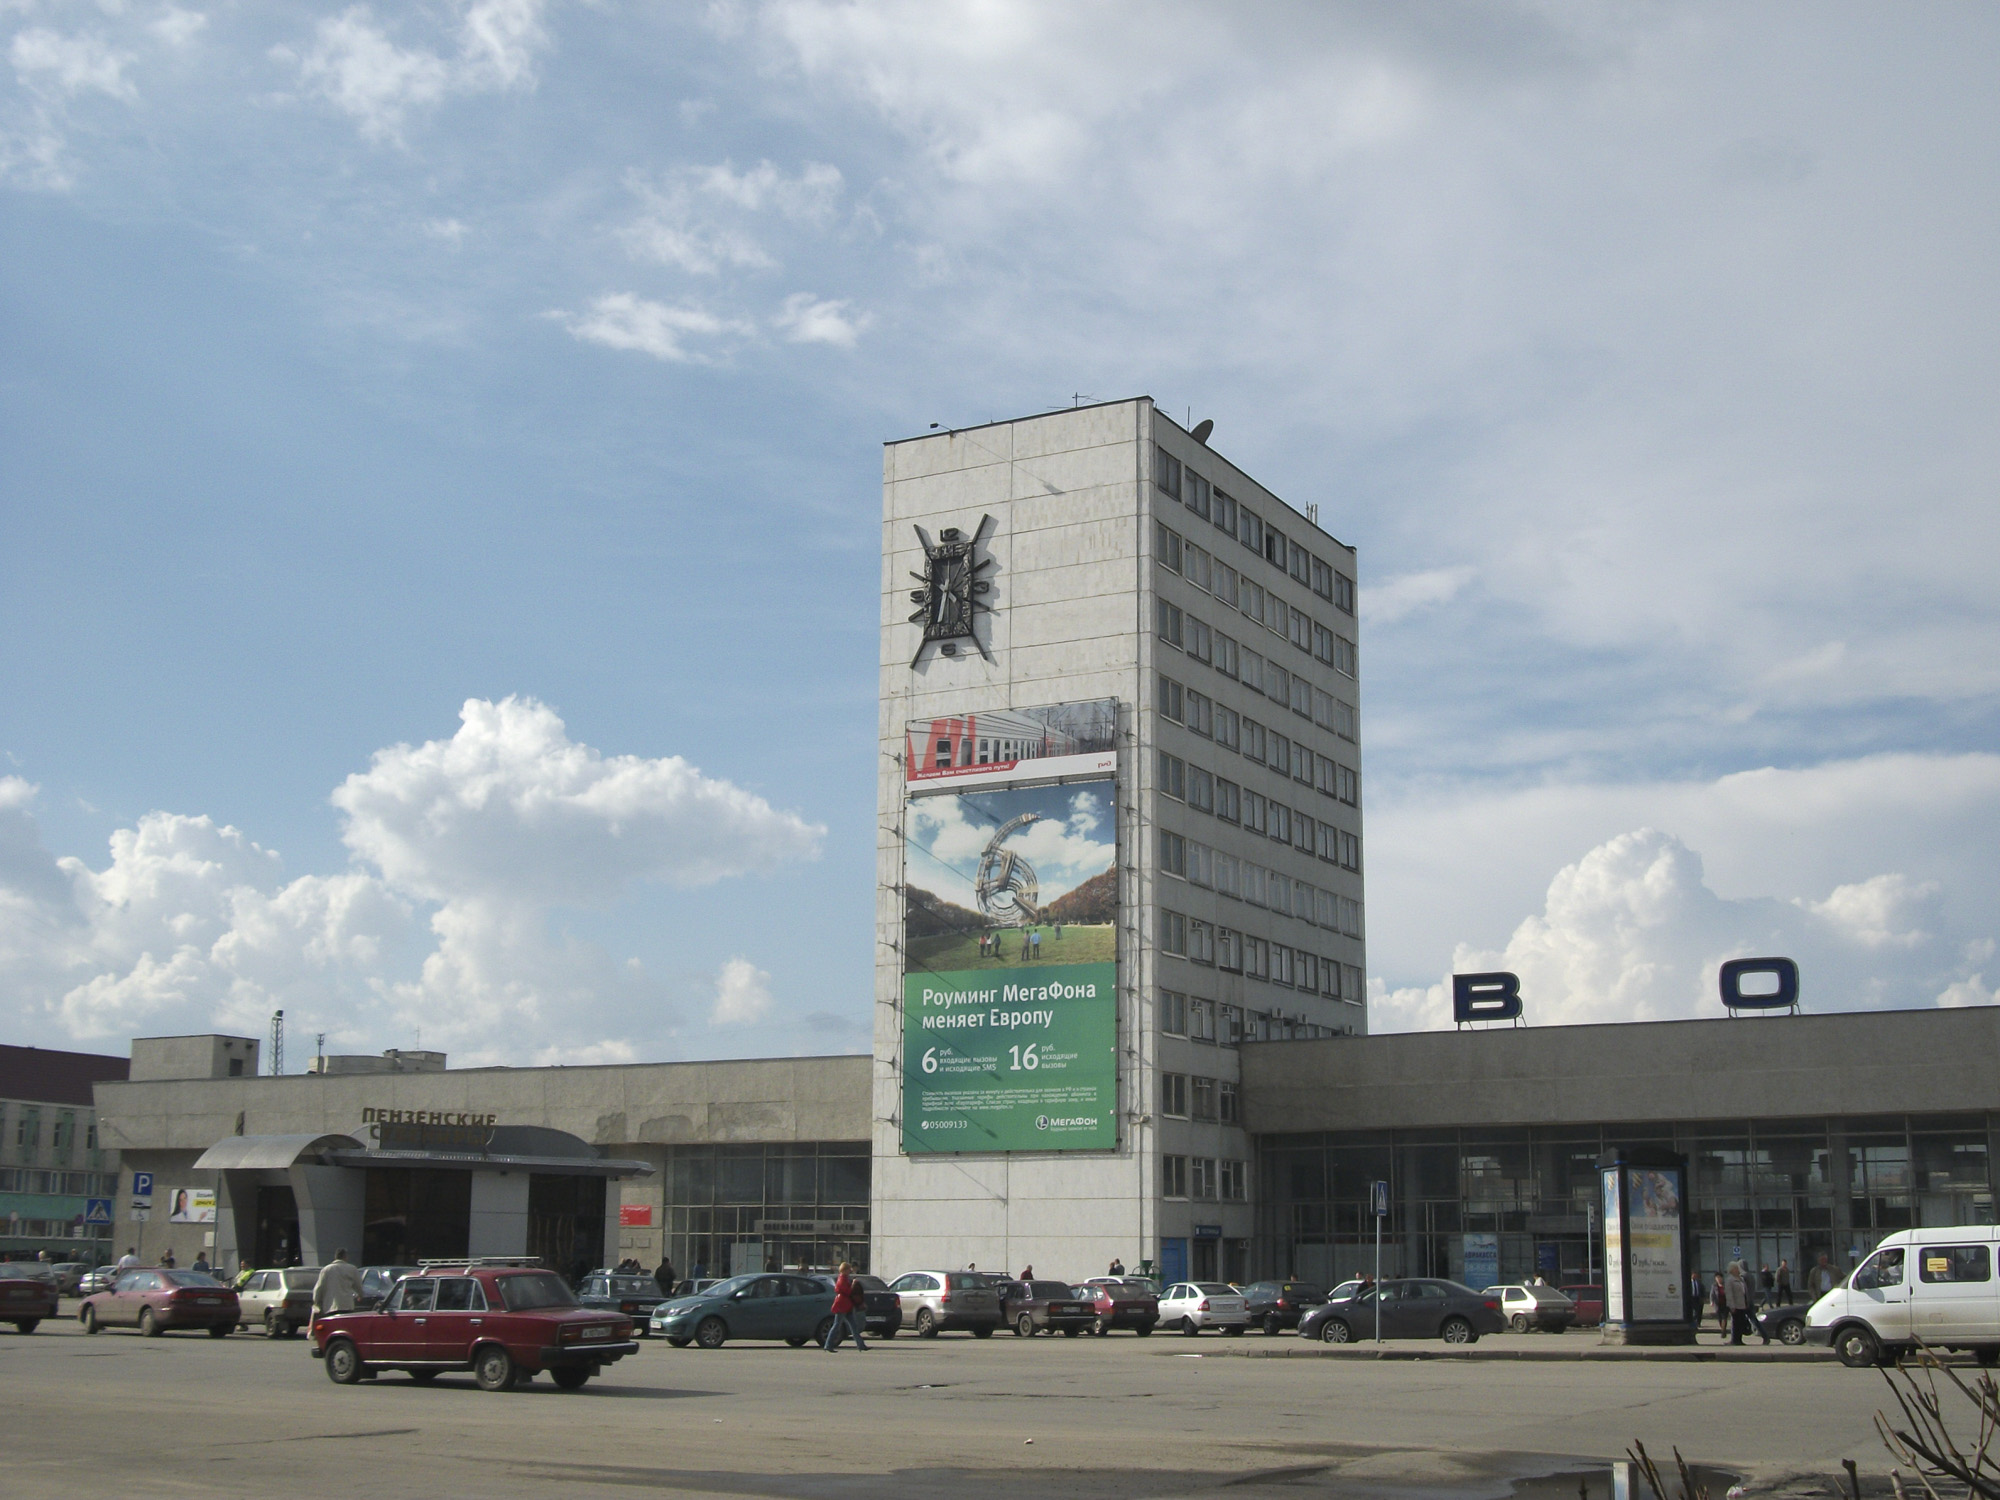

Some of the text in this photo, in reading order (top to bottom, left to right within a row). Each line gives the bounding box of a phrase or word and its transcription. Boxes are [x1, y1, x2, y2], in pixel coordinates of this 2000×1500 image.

[922, 981, 1096, 1009] Роуминг МегаФона
[922, 1009, 1053, 1030] меняет Европу
[939, 1048, 954, 1058] руб.
[1041, 1044, 1056, 1053] руб.
[922, 1046, 938, 1074] 6
[939, 1055, 998, 1065] входящие вызовы
[1008, 1042, 1039, 1071] 16
[1041, 1053, 1078, 1061] исходящие
[945, 1065, 981, 1073] исходящие
[982, 1063, 997, 1072] SMS
[362, 1107, 497, 1127] ПЕНЗЕНСКИЕ
[930, 1120, 968, 1130] 05009133
[138, 1175, 150, 1193] P
